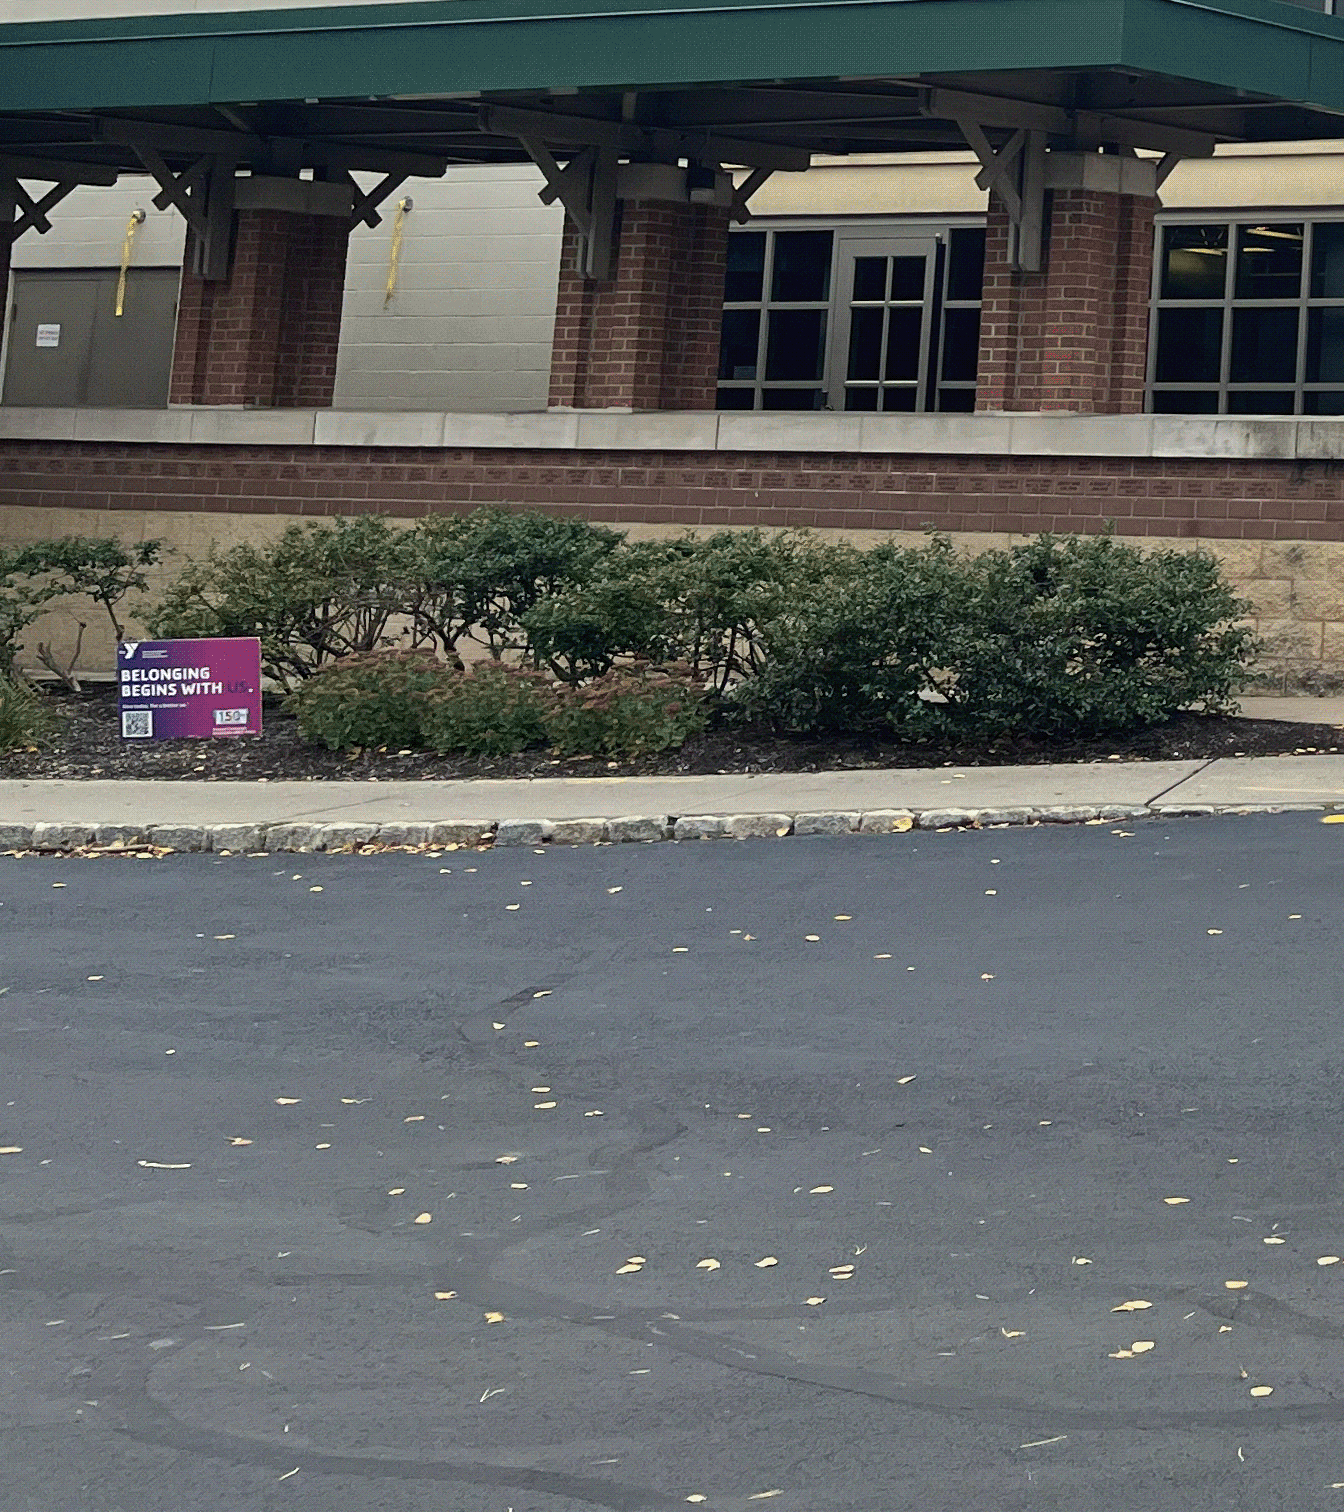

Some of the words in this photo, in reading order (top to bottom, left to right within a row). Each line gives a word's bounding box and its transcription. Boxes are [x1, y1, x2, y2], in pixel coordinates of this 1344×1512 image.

[120, 666, 210, 682] BELONGING
[121, 683, 177, 697] BEGINS
[181, 681, 223, 695] WITH
